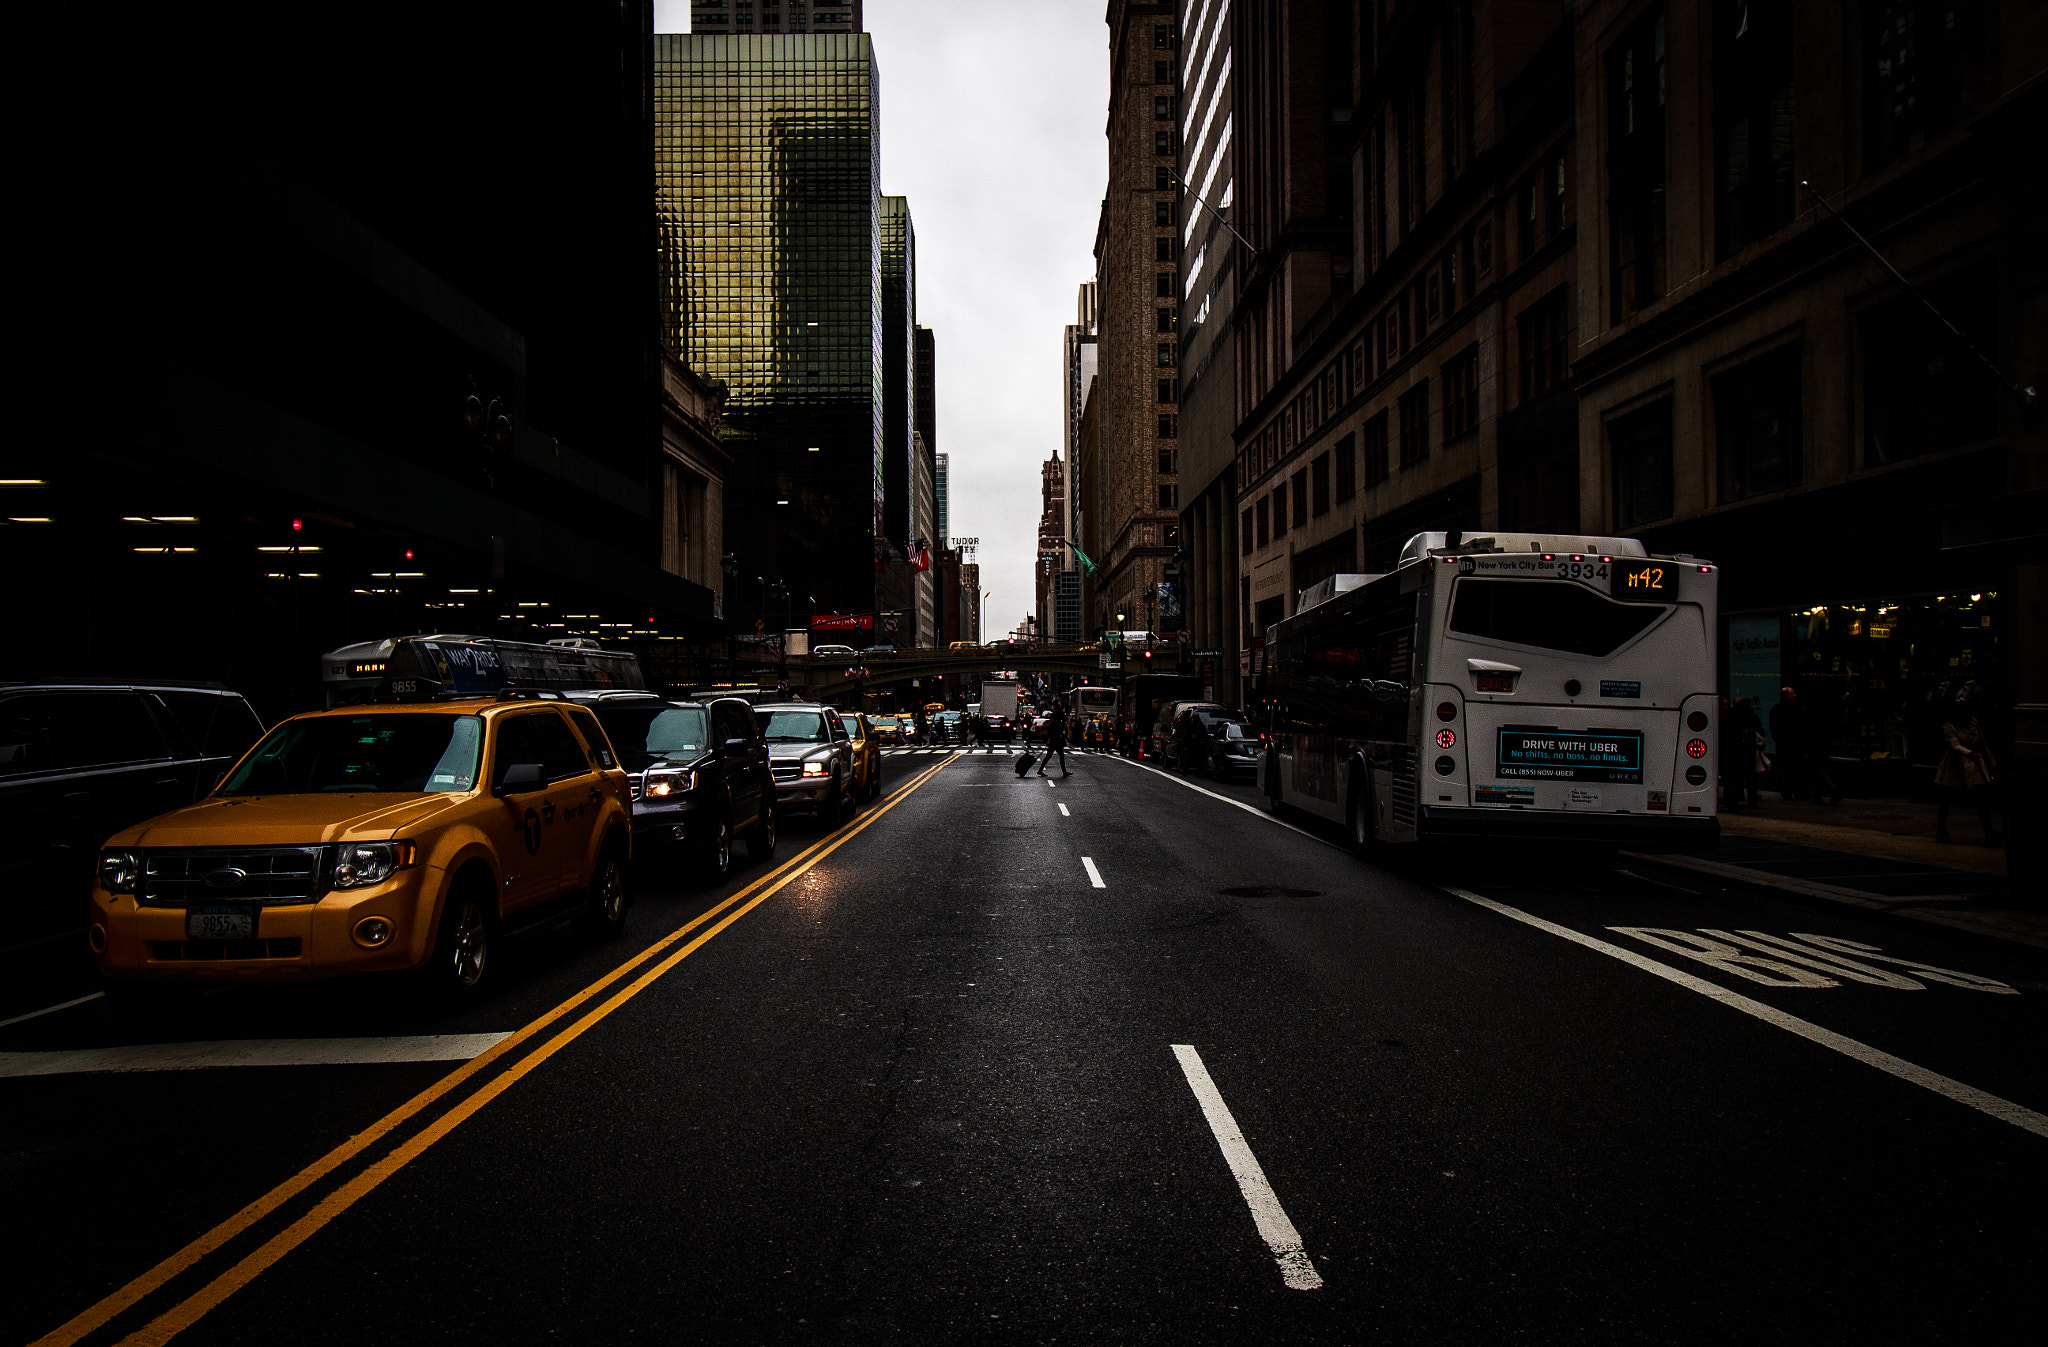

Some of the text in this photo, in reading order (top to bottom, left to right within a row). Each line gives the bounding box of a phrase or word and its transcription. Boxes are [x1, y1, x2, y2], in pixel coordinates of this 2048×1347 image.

[951, 537, 979, 545] TUDOR
[1478, 561, 1555, 571] New York City Bus
[1557, 563, 1609, 581] 3934
[1628, 567, 1664, 589] M42
[391, 680, 417, 694] 9B55
[1522, 740, 1618, 753] DRIVE WITH UBER
[1511, 749, 1523, 758] No
[1603, 753, 1629, 762] limits.
[1500, 767, 1574, 777] CALL (855) NOW-UBER
[1603, 926, 2021, 996] BUS
